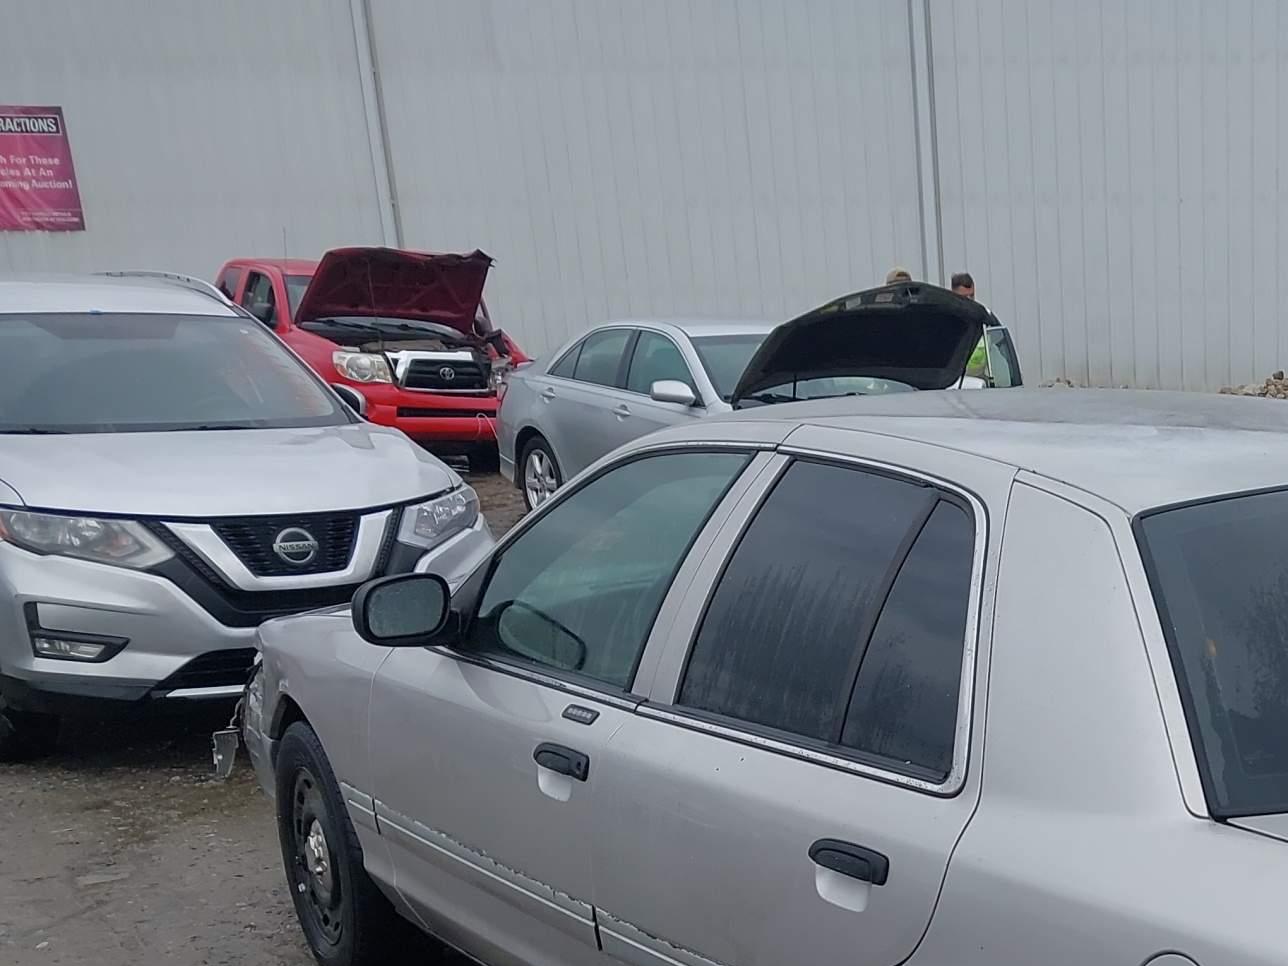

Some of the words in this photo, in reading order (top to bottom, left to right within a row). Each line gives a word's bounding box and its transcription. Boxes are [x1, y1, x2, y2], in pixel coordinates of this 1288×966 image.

[9, 155, 26, 165] For
[28, 155, 60, 165] These
[24, 167, 36, 177] At
[40, 167, 54, 177] An
[31, 179, 73, 189] Auction!
